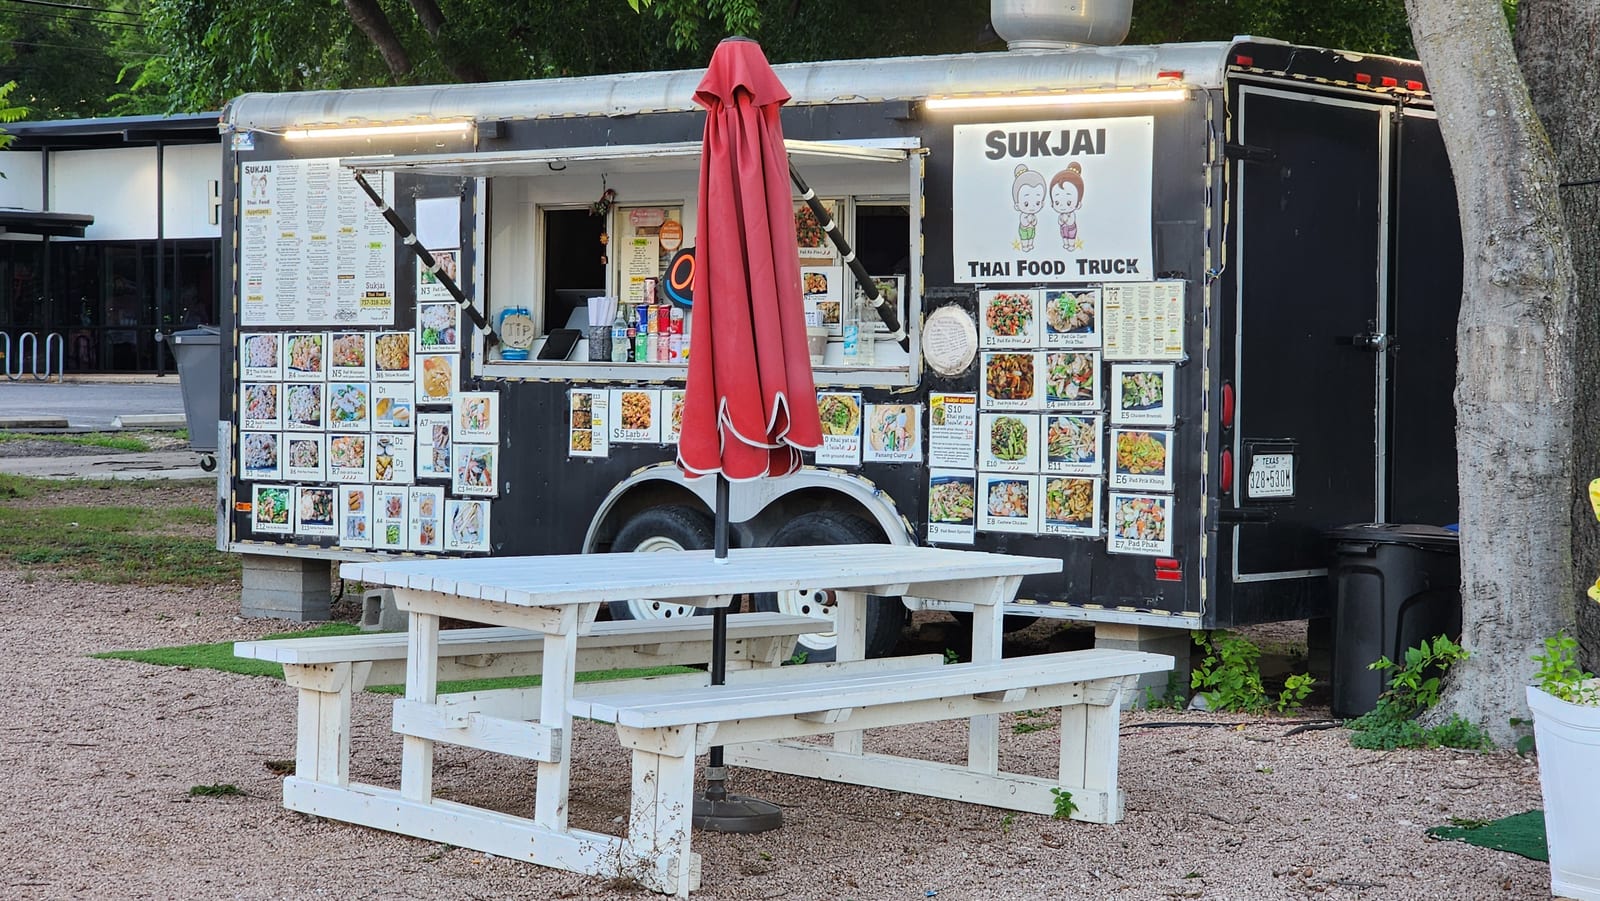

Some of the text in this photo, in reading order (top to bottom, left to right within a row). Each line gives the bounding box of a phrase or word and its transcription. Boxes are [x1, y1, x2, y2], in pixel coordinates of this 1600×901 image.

[985, 128, 1106, 160] SUKJAI
[245, 165, 272, 174] SUKJAI
[968, 258, 1140, 277] THAI FOOD TRUCK
[366, 282, 385, 290] Sukjai
[421, 286, 430, 296] N3
[986, 337, 995, 345] E1
[332, 369, 342, 377] N5
[947, 405, 962, 413] S10
[245, 420, 254, 428] R2
[420, 418, 428, 427] A7
[614, 428, 625, 438] S5
[1263, 457, 1279, 465] TEXAS
[1116, 475, 1127, 484] E6
[930, 525, 939, 533] E9
